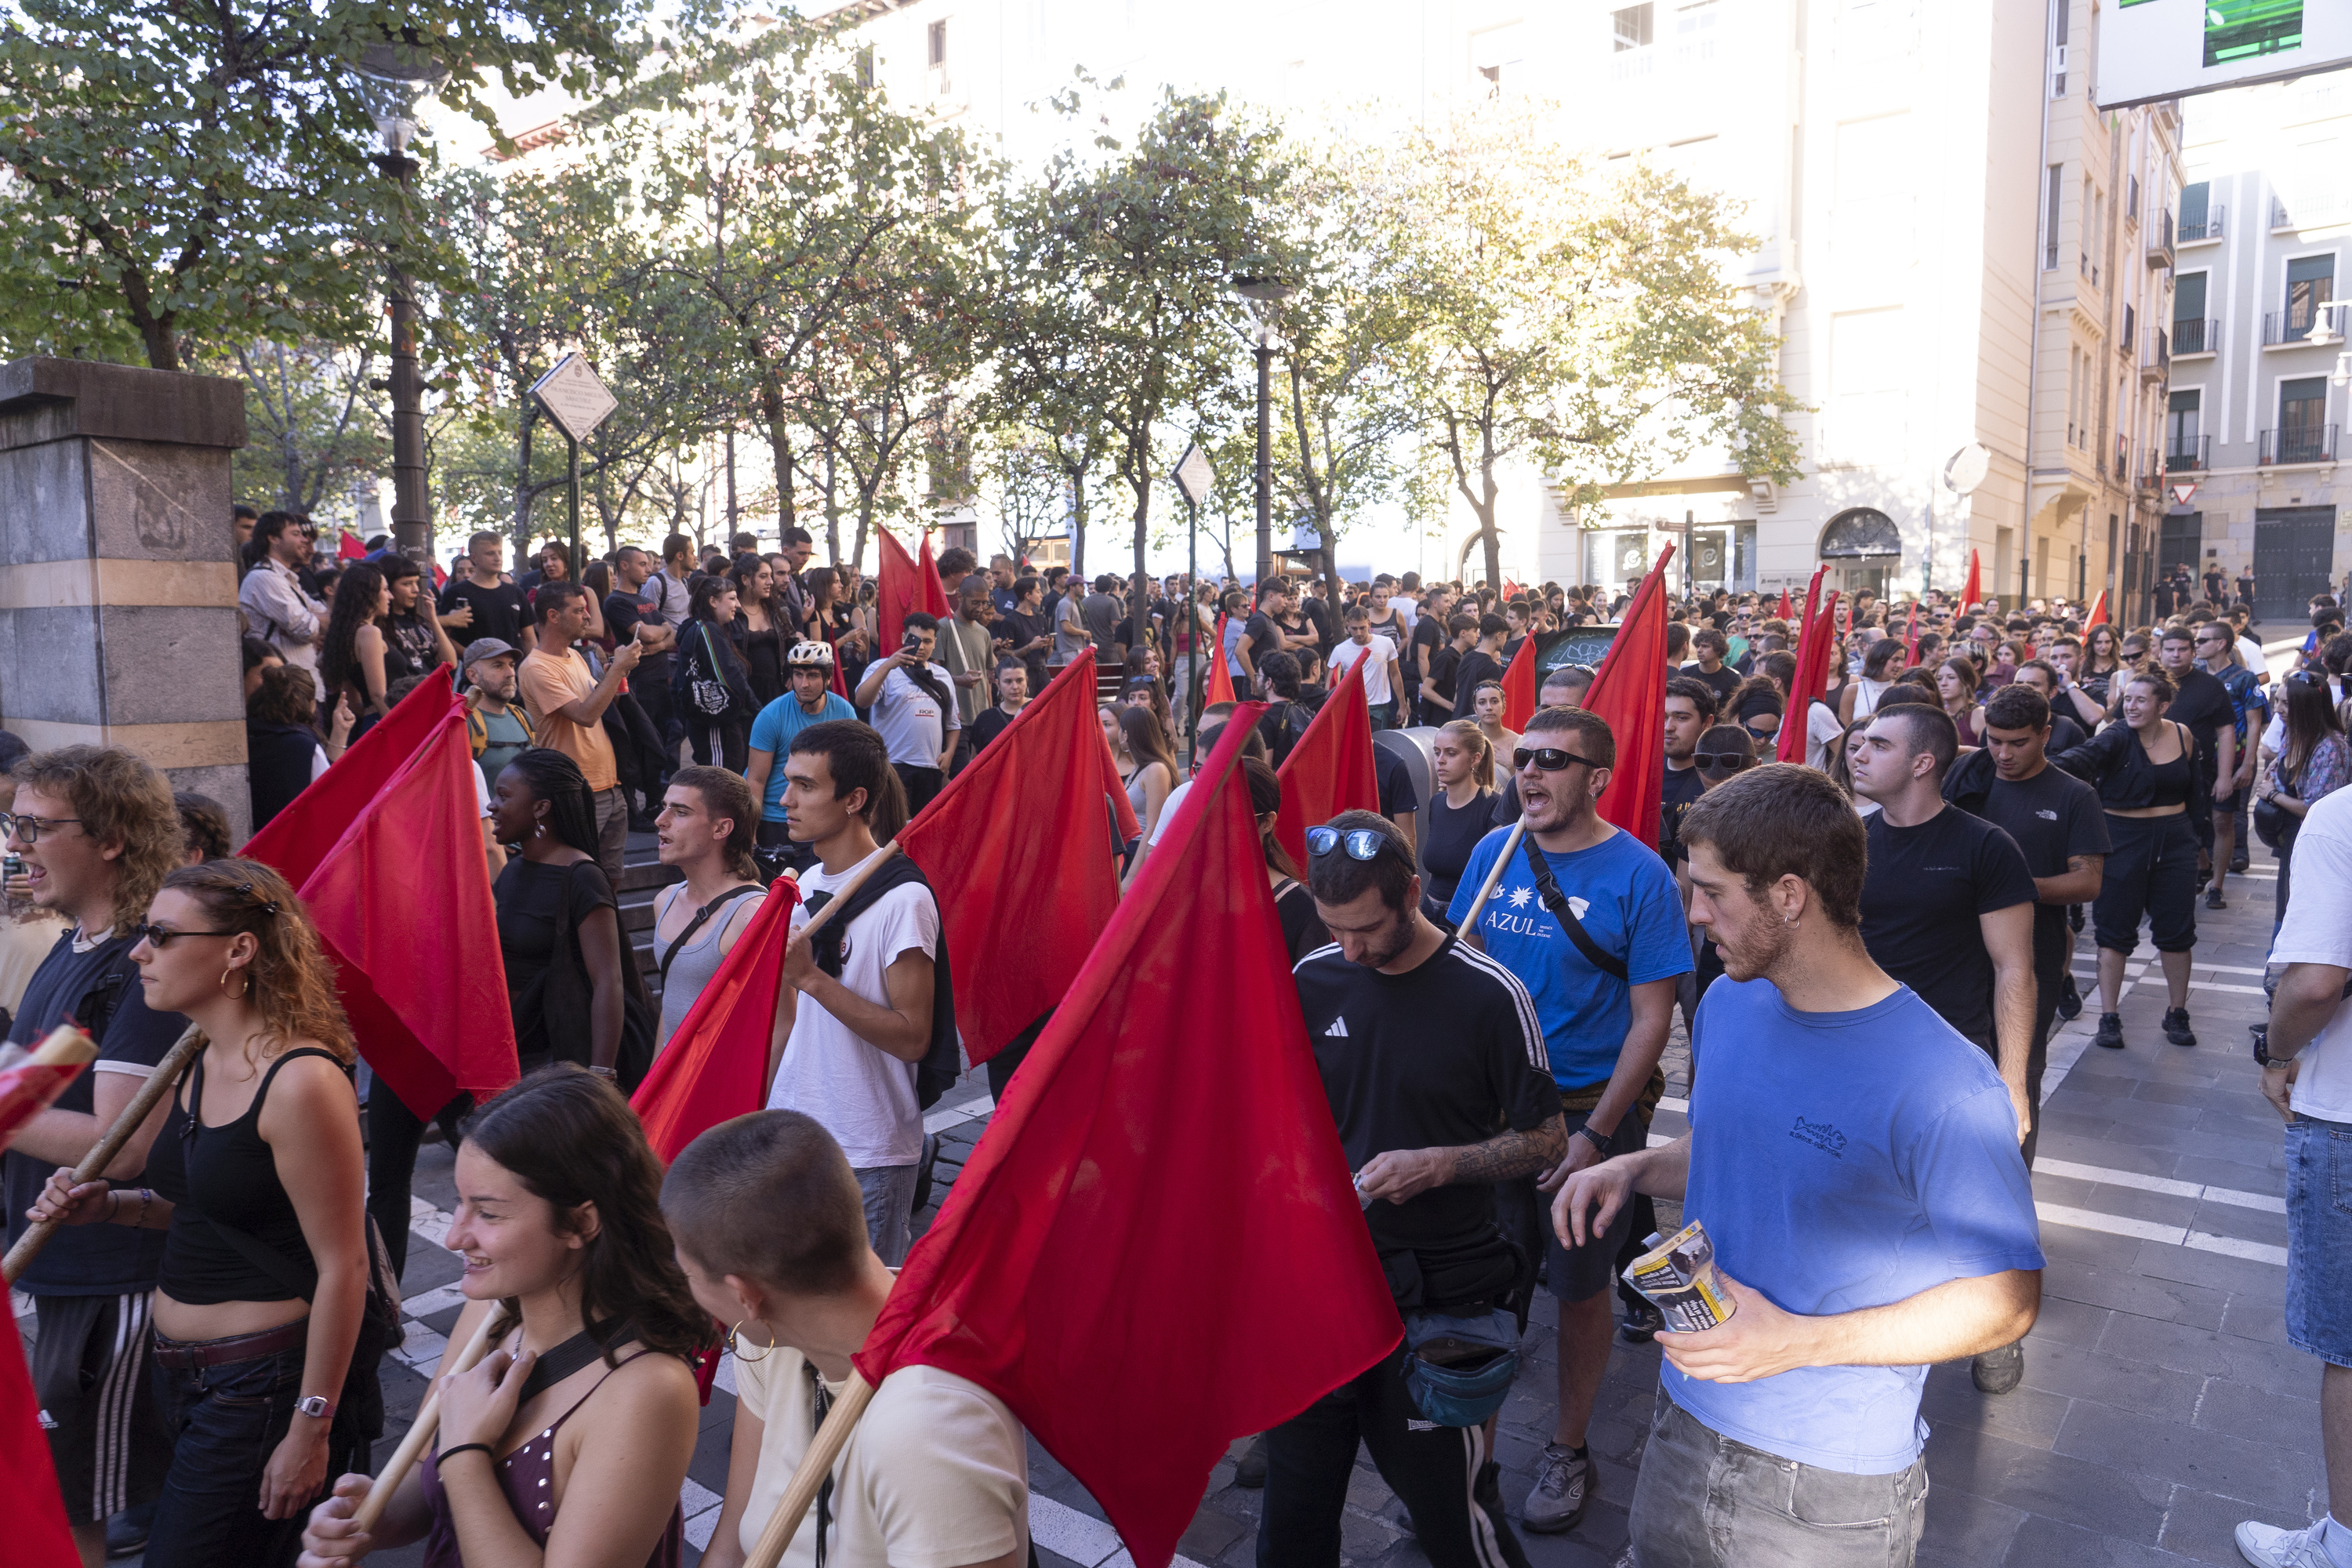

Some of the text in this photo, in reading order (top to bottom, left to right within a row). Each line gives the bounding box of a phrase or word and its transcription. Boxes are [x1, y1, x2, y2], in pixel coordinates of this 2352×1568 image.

[1486, 911, 1537, 935] AZUL
[1659, 1266, 1671, 1275] que
[1690, 1300, 1700, 1309] hijo
[1708, 1315, 1717, 1325] que
